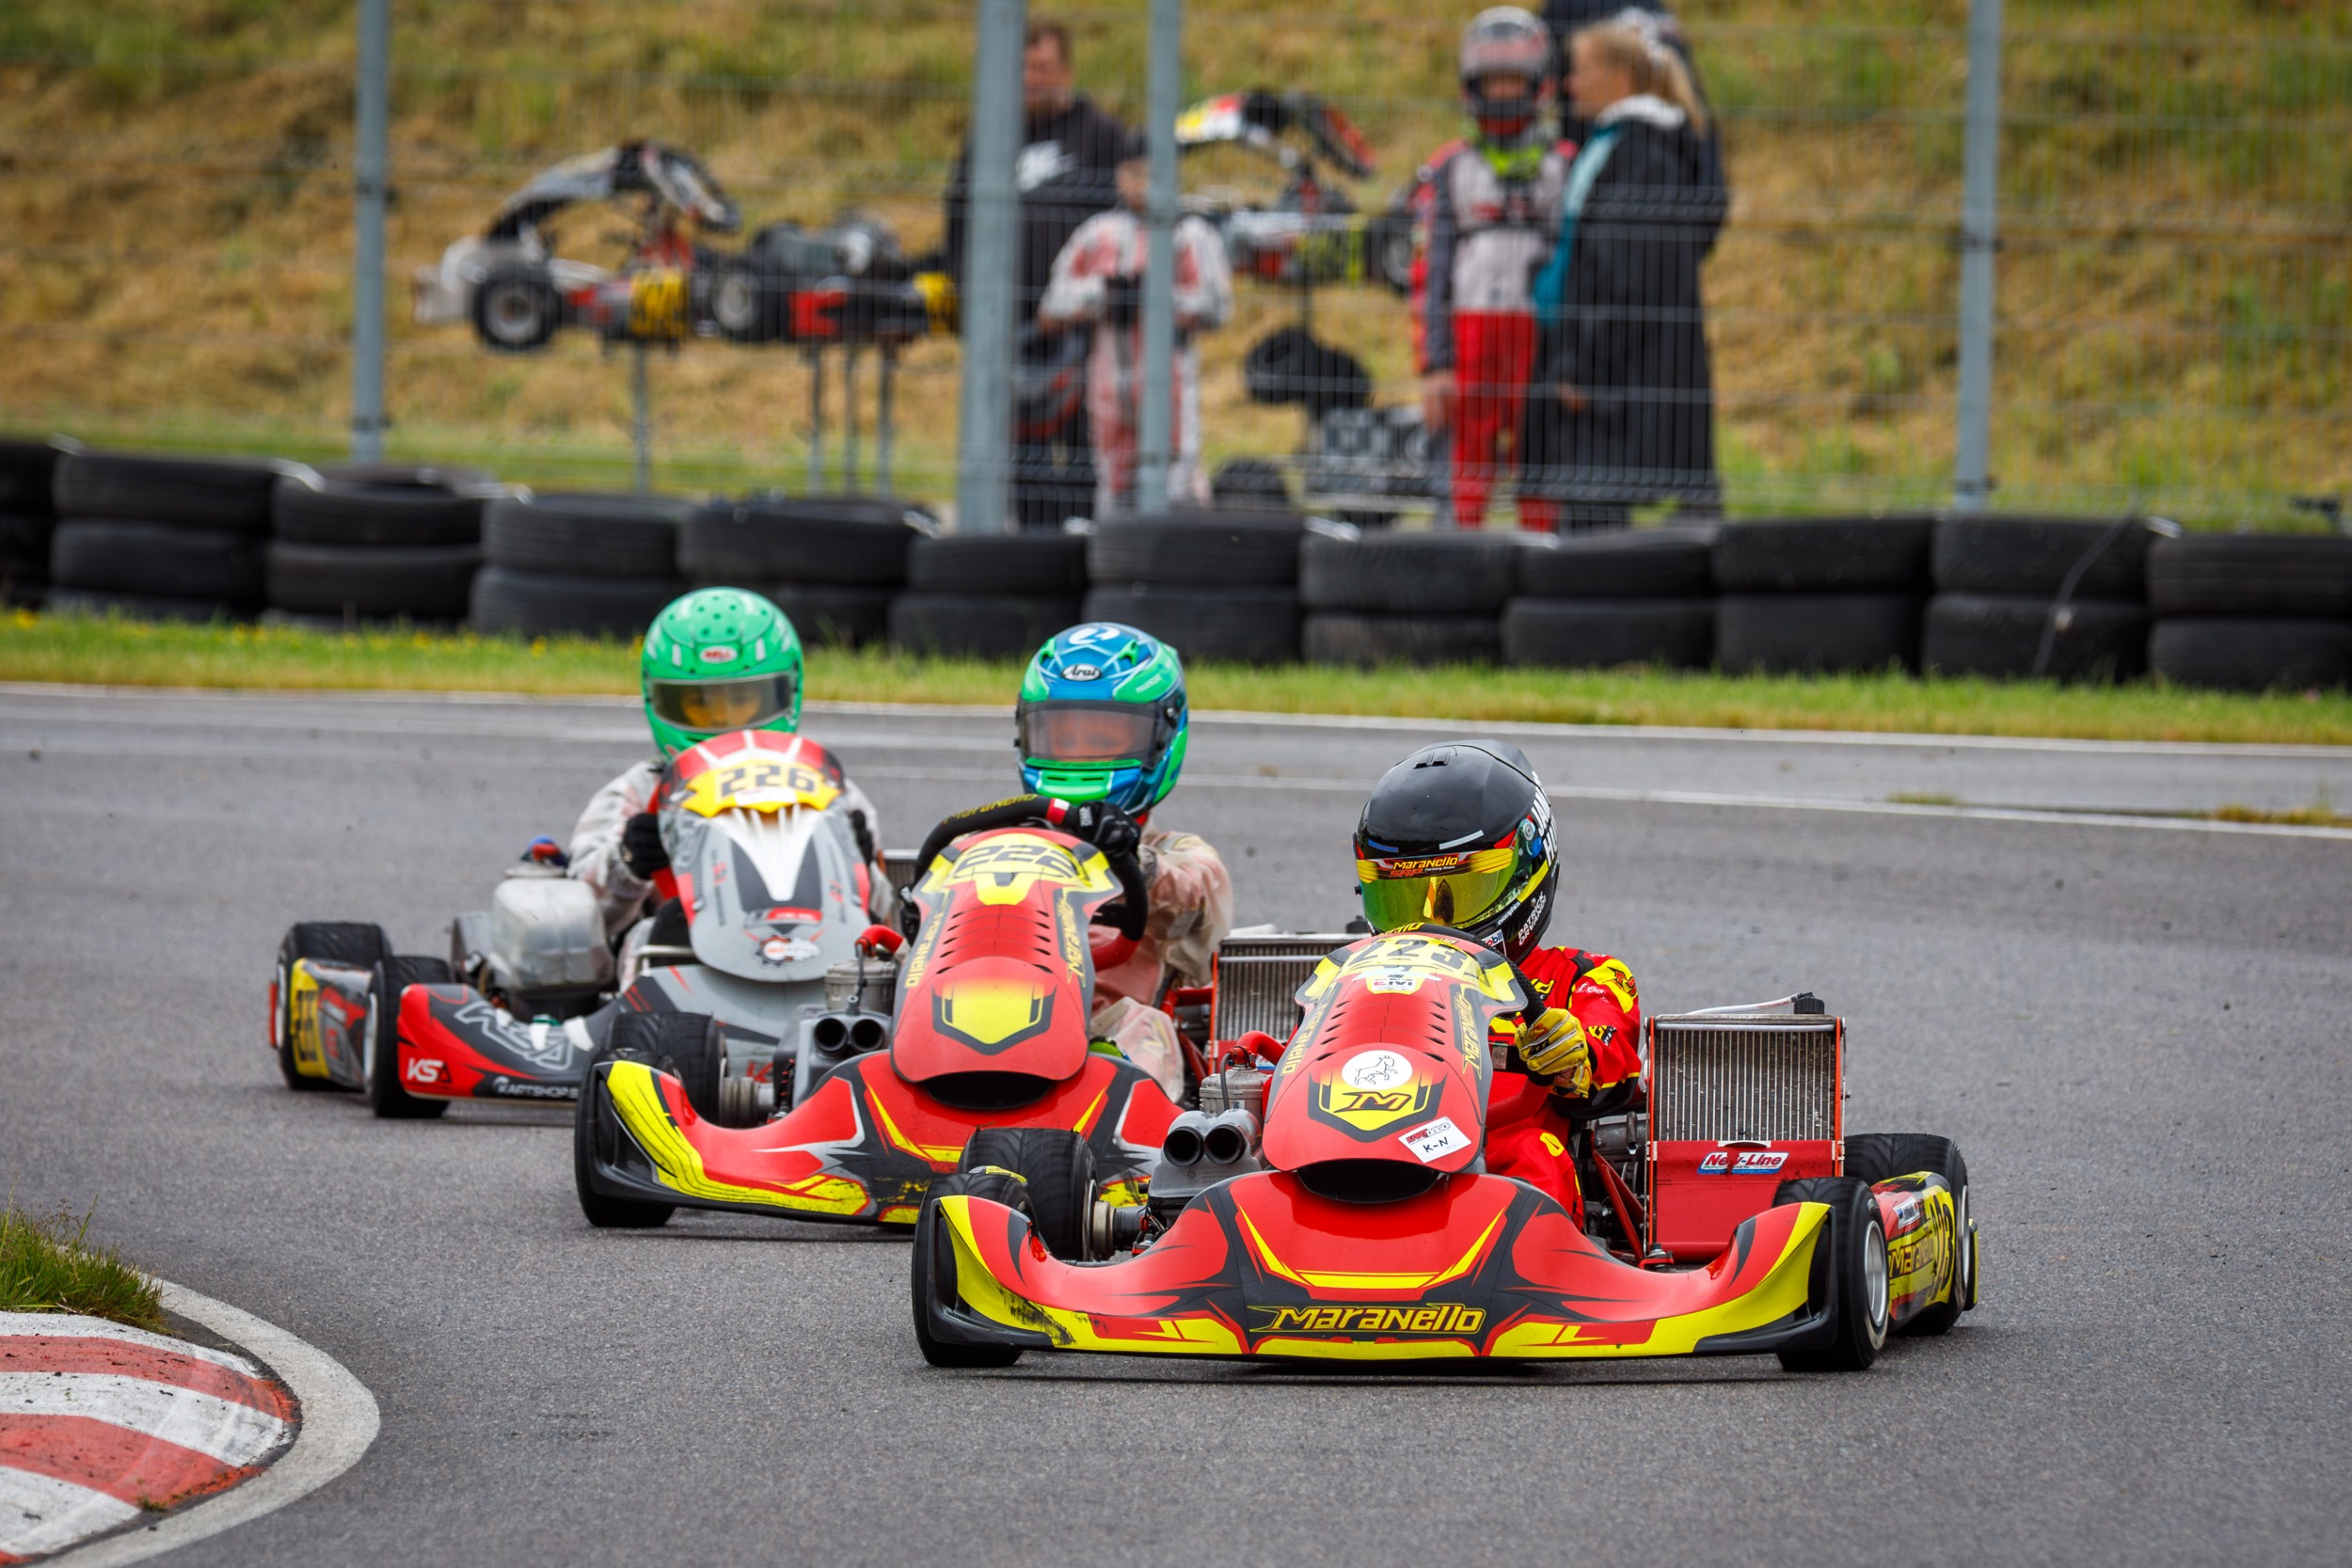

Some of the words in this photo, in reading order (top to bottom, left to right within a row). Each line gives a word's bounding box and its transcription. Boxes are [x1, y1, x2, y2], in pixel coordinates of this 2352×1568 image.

[1066, 664, 1099, 677] Arai
[720, 764, 816, 798] 226
[1422, 1136, 1450, 1153] K-N
